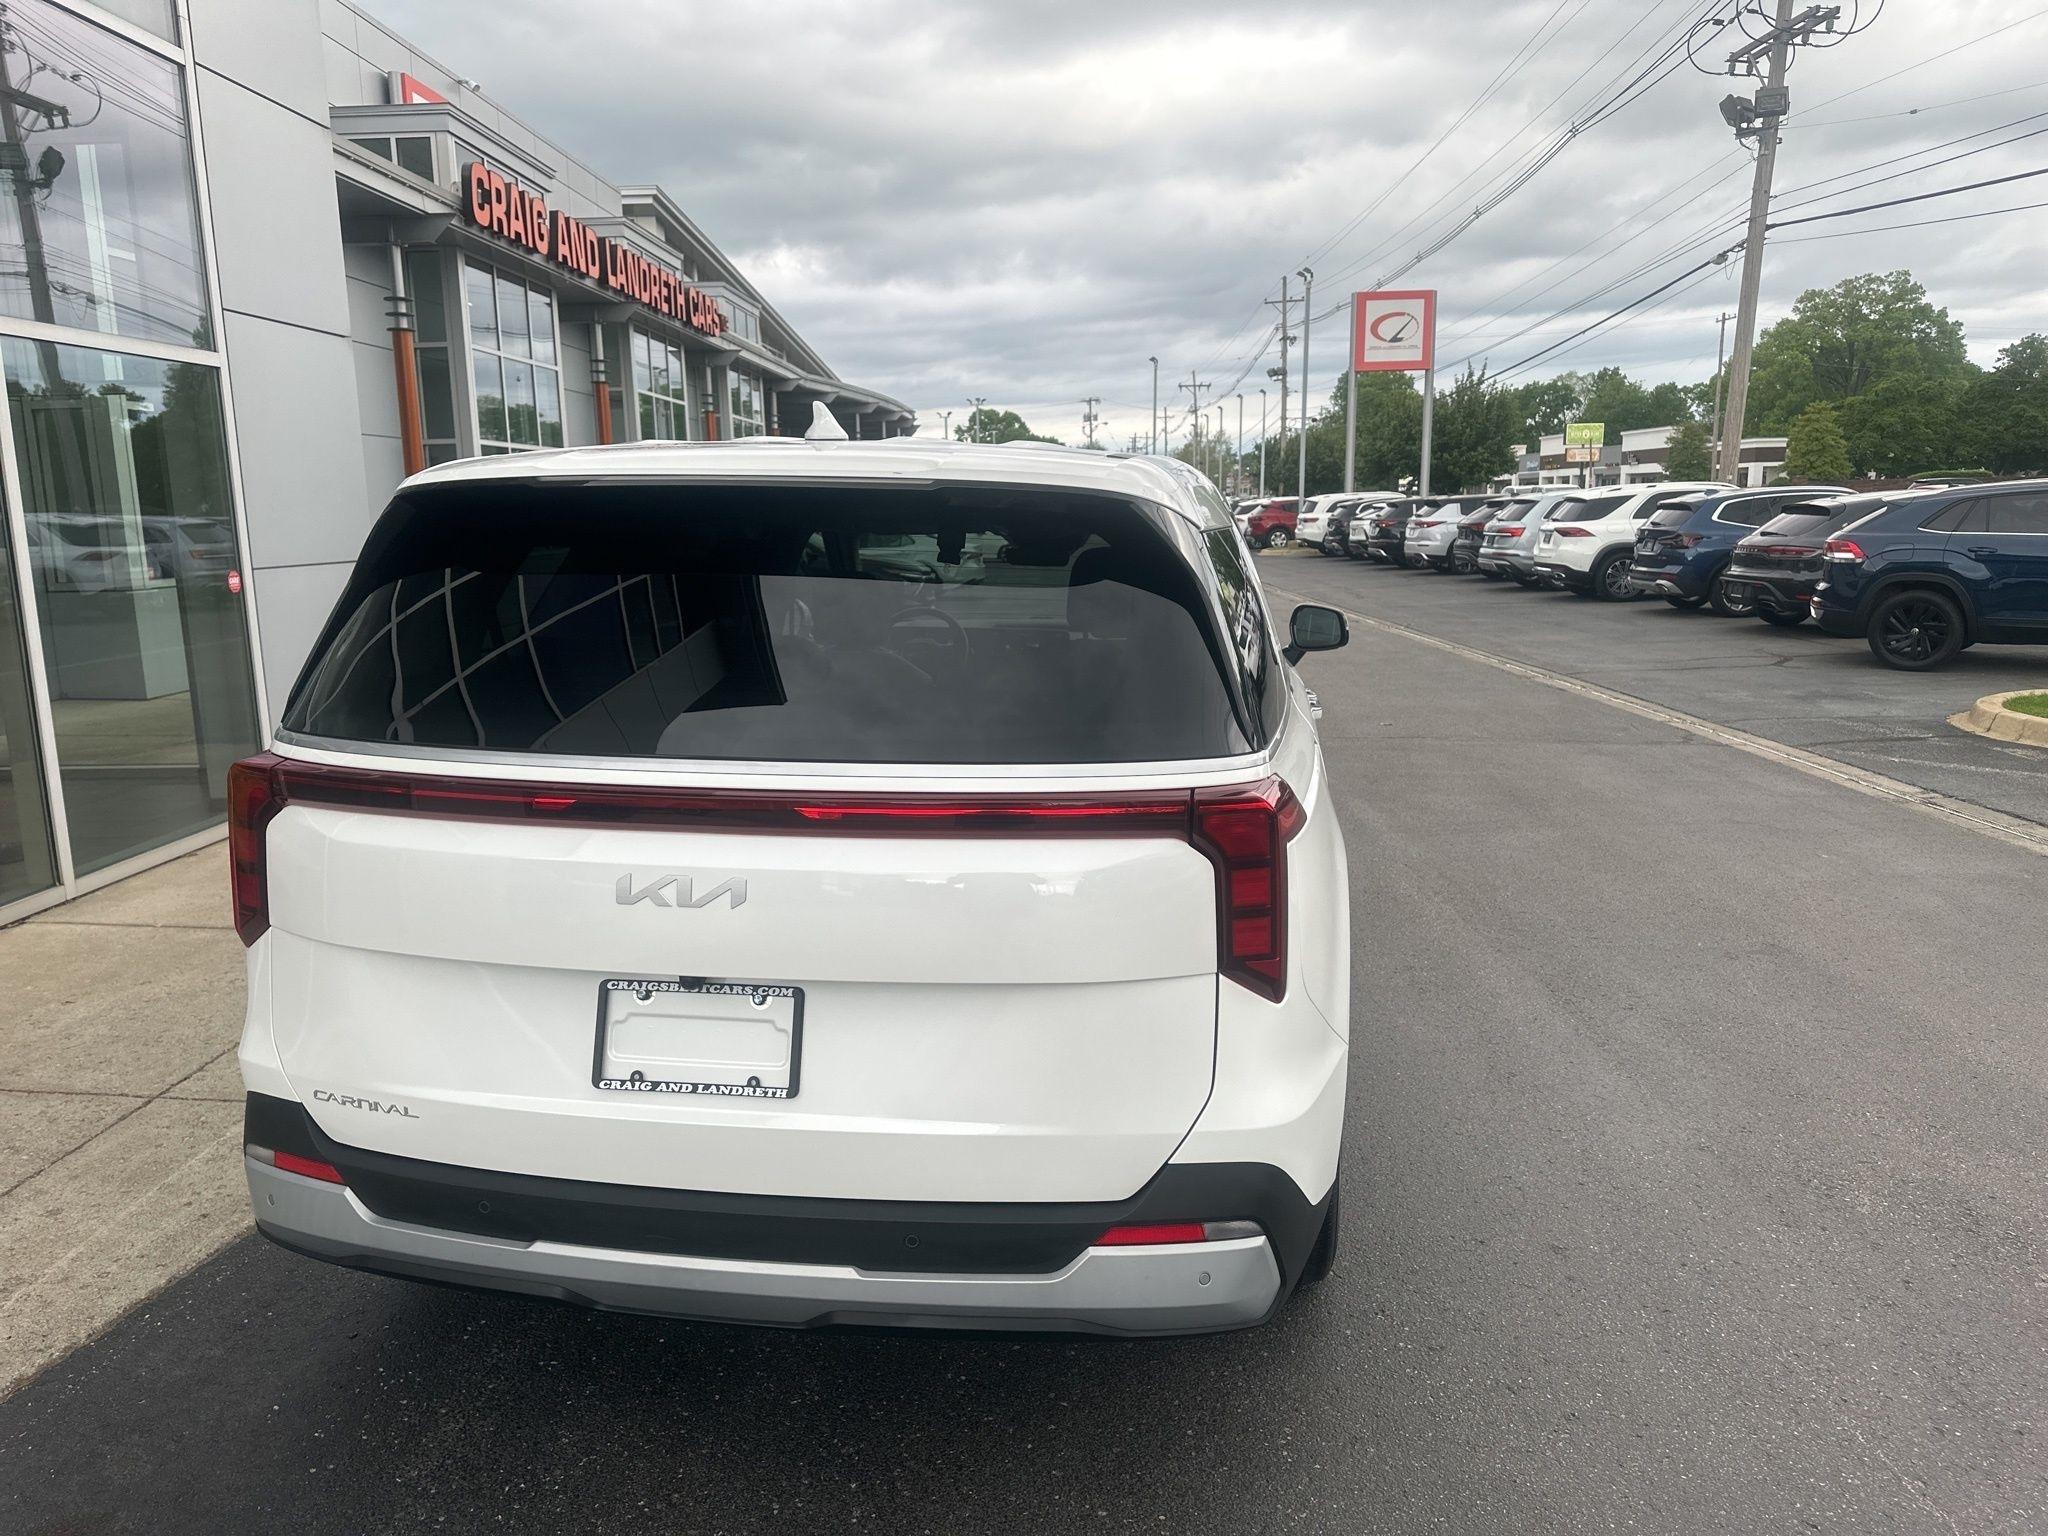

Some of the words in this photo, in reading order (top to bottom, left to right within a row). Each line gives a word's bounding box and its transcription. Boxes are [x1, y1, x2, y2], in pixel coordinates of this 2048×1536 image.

[468, 161, 549, 255] CRAIG
[555, 210, 600, 279] AND
[604, 238, 687, 322] LANDRETH
[689, 286, 720, 337] CARS
[616, 873, 747, 909] KIA
[606, 980, 794, 998] CRAIGSBTCARS.COM
[313, 1089, 420, 1119] CARNIVAL
[599, 1079, 653, 1092] CRAIG
[655, 1081, 693, 1094] AND
[697, 1083, 789, 1099] LANDRETH
